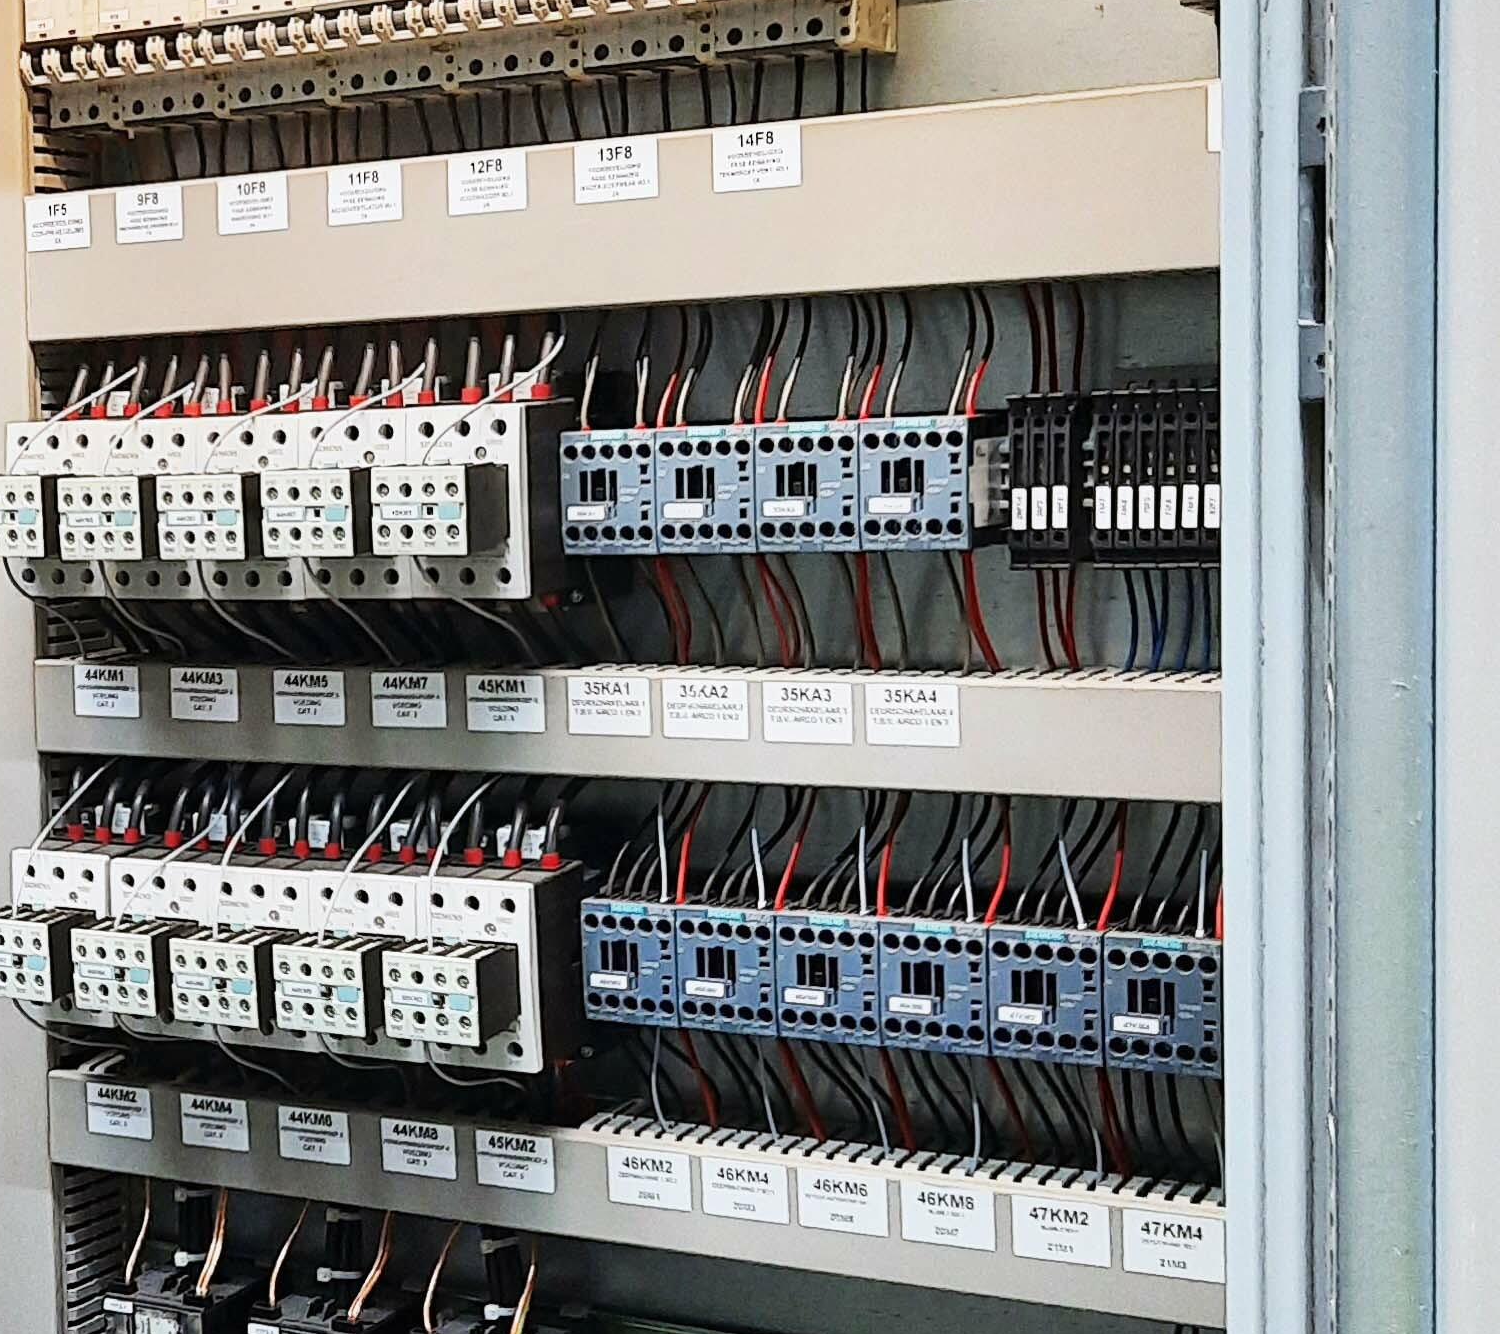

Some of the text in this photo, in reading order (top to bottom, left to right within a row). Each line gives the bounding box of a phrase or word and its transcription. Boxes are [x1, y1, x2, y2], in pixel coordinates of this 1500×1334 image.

[737, 130, 774, 148] 14F8
[598, 145, 633, 162] 13F8
[470, 158, 503, 175] 12F8
[348, 170, 379, 186] 11F8
[237, 181, 266, 196] 10F8
[137, 192, 159, 206] 9F8
[48, 203, 67, 217] 1F5
[84, 669, 124, 682] 44KM1
[180, 670, 223, 685] 44KM3
[284, 673, 328, 688] 44KM5
[383, 676, 428, 689] 44KM7
[478, 679, 526, 694] 45KM1
[584, 681, 630, 696] 35KA1
[679, 684, 729, 699] 35KA2
[781, 687, 832, 702] 35KA3
[884, 688, 937, 704] 35KA4
[97, 1087, 138, 1103] 44KM2
[191, 1098, 233, 1114] 44KM4
[488, 1135, 536, 1153] 45KM2
[622, 1156, 673, 1174] 46KM2
[717, 1167, 769, 1185] 46KM4
[813, 1178, 868, 1197] 46KM6
[1029, 1206, 1089, 1226] 47KM2
[1140, 1221, 1203, 1241] 47KM4
